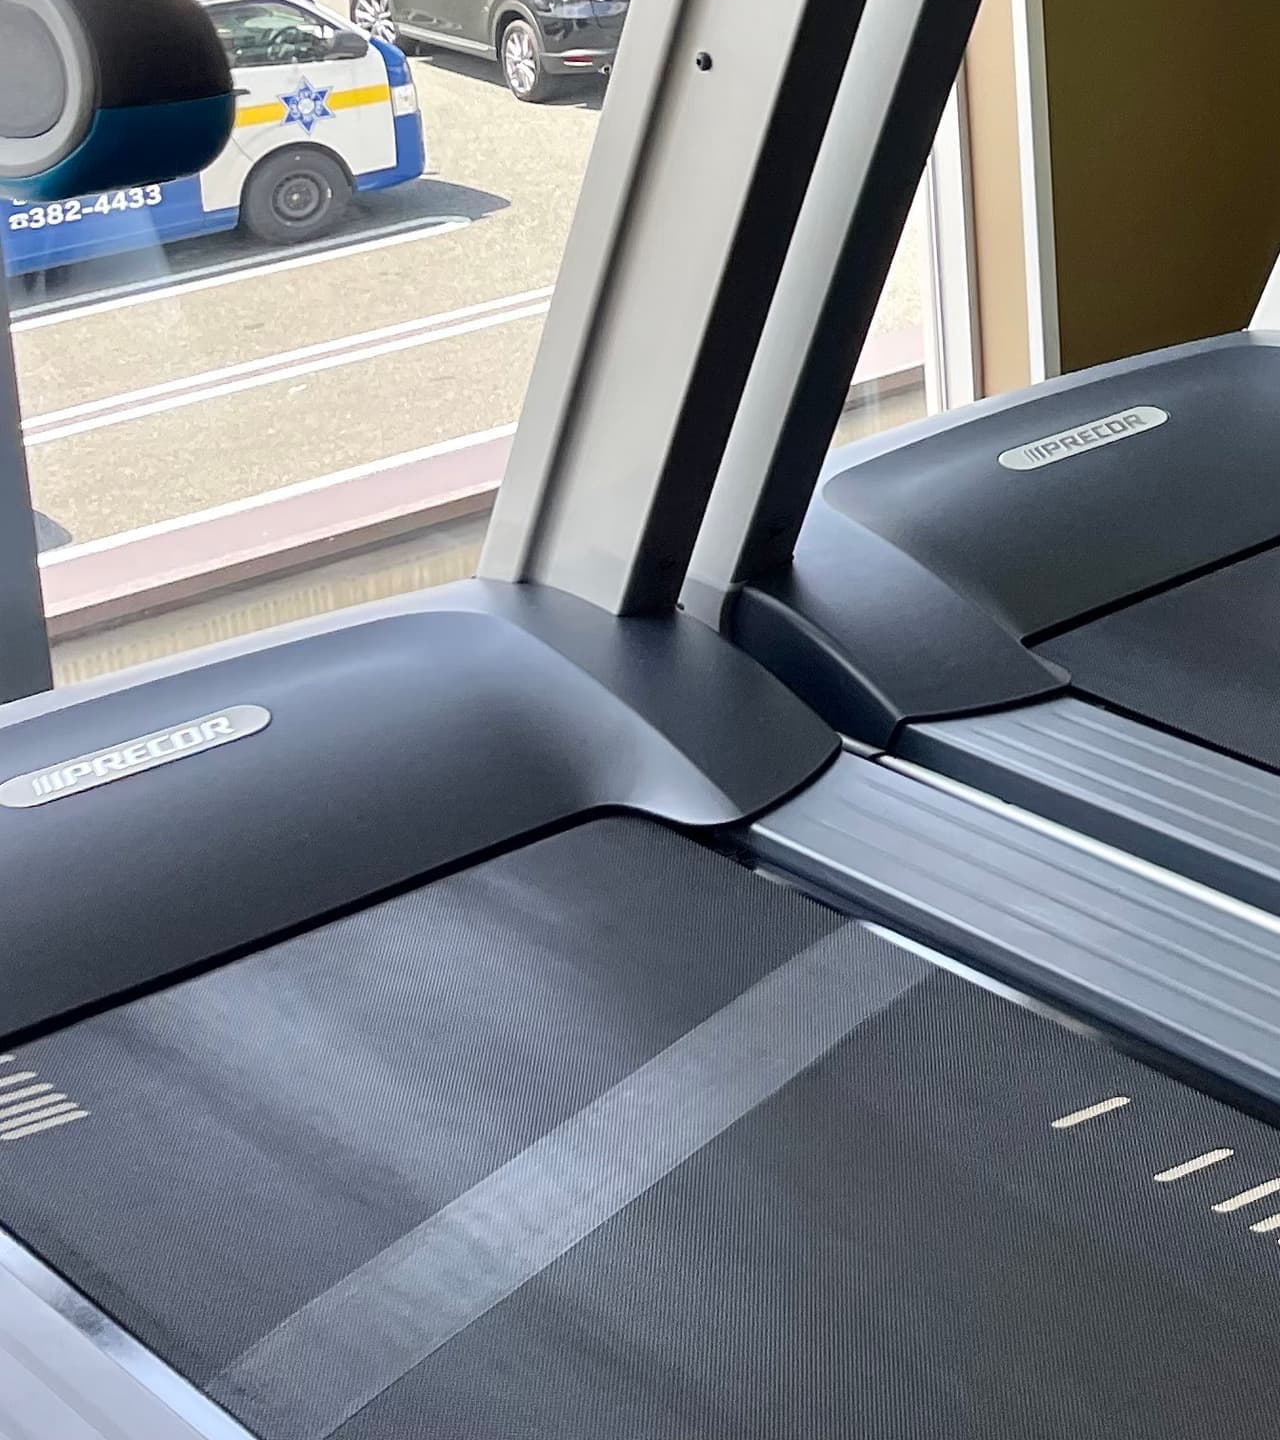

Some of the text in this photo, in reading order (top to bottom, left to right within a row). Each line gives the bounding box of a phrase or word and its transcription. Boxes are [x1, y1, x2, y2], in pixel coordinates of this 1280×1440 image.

[28, 184, 162, 229] 382-4433
[1040, 413, 1147, 458] PRECOR
[62, 716, 235, 788] PRECOR
